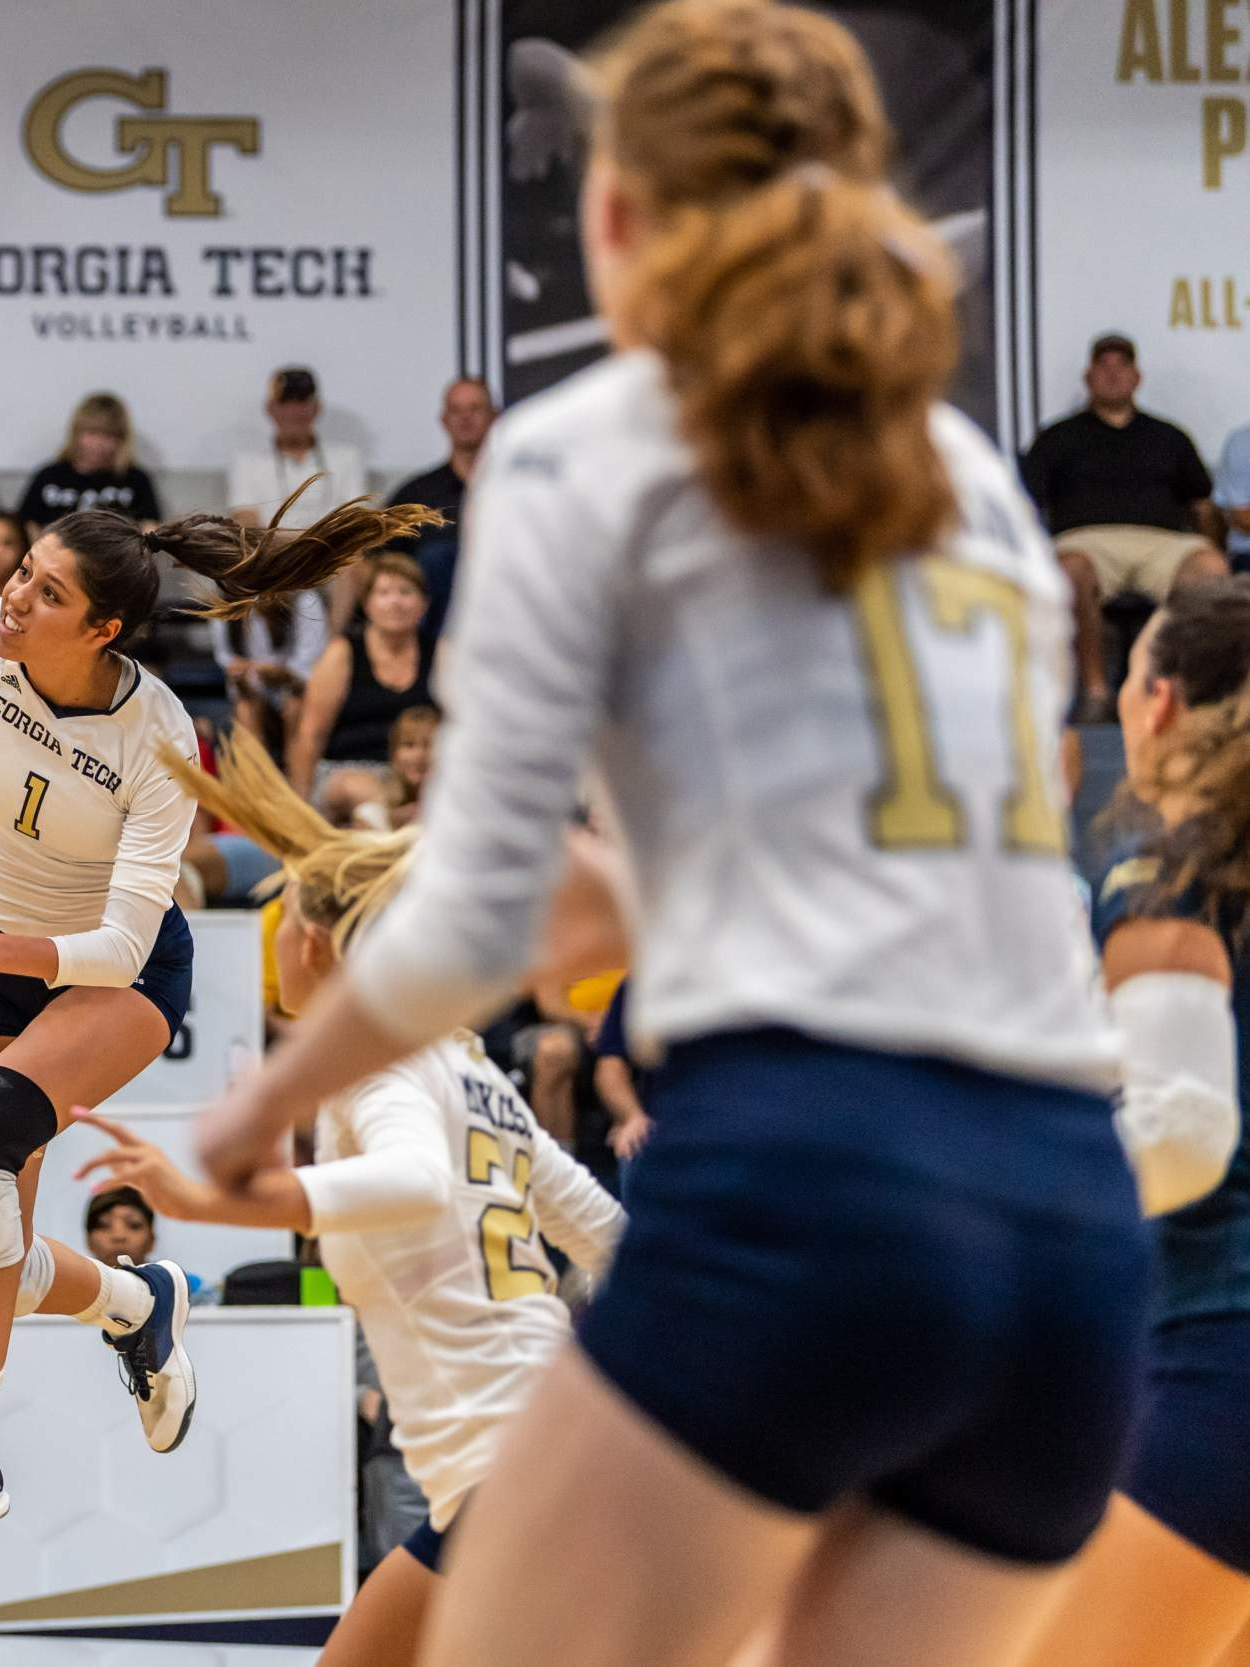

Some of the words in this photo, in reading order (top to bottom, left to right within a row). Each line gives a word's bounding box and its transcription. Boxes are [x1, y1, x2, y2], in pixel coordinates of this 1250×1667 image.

[22, 67, 261, 219] GT
[203, 246, 372, 297] TECH
[33, 312, 249, 342] VOLLEYBALL
[71, 748, 122, 795] TECH
[14, 771, 50, 840] 1
